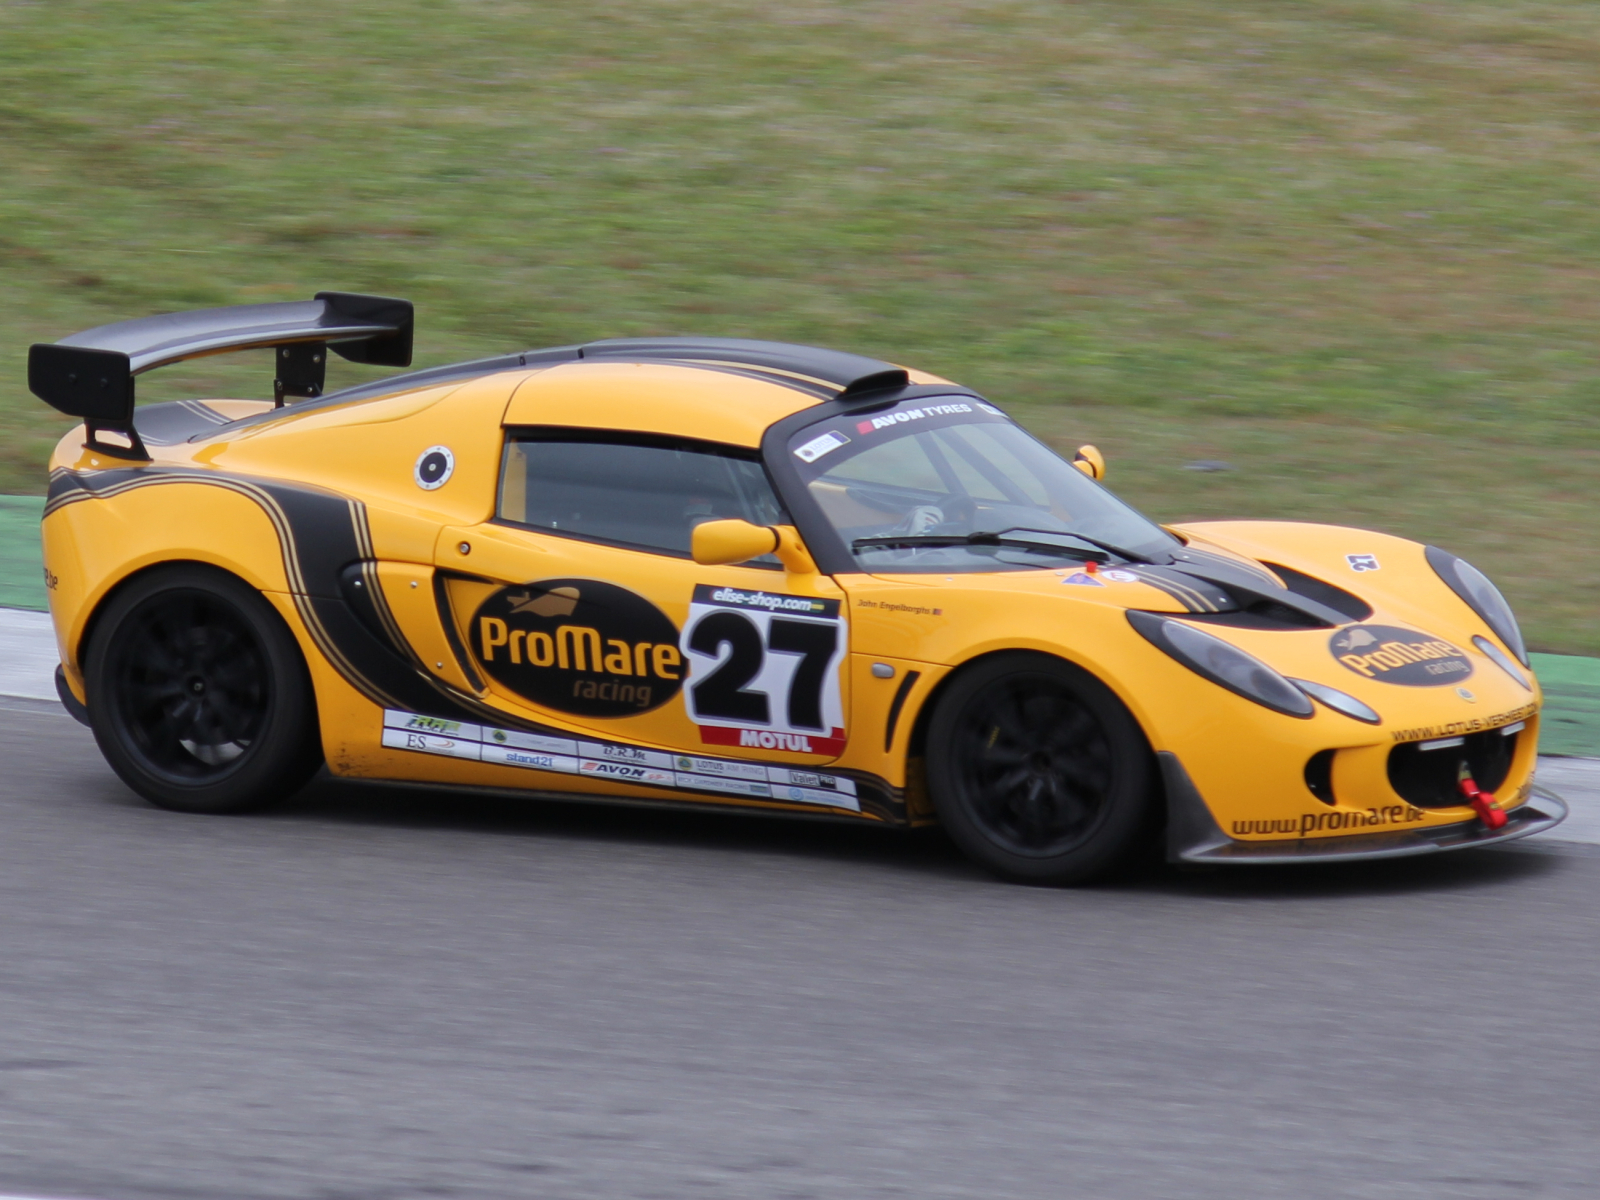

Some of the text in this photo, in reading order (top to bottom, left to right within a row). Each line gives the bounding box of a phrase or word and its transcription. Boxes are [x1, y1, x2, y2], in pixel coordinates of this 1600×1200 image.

[871, 409, 925, 430] AVON
[923, 403, 973, 417] TYRES
[1346, 554, 1379, 572] 27
[713, 588, 811, 611] elise-shop.com
[857, 599, 878, 608] John
[480, 617, 682, 680] ProMare
[1339, 640, 1463, 678] ProMare
[690, 611, 839, 730] 27
[1423, 659, 1471, 676] racing
[573, 679, 652, 706] racing
[406, 734, 427, 750] ES
[740, 730, 813, 753] MOTUL
[597, 764, 646, 777] AVON
[696, 760, 724, 771] LOTUS
[1232, 804, 1425, 837] www.promare.be
